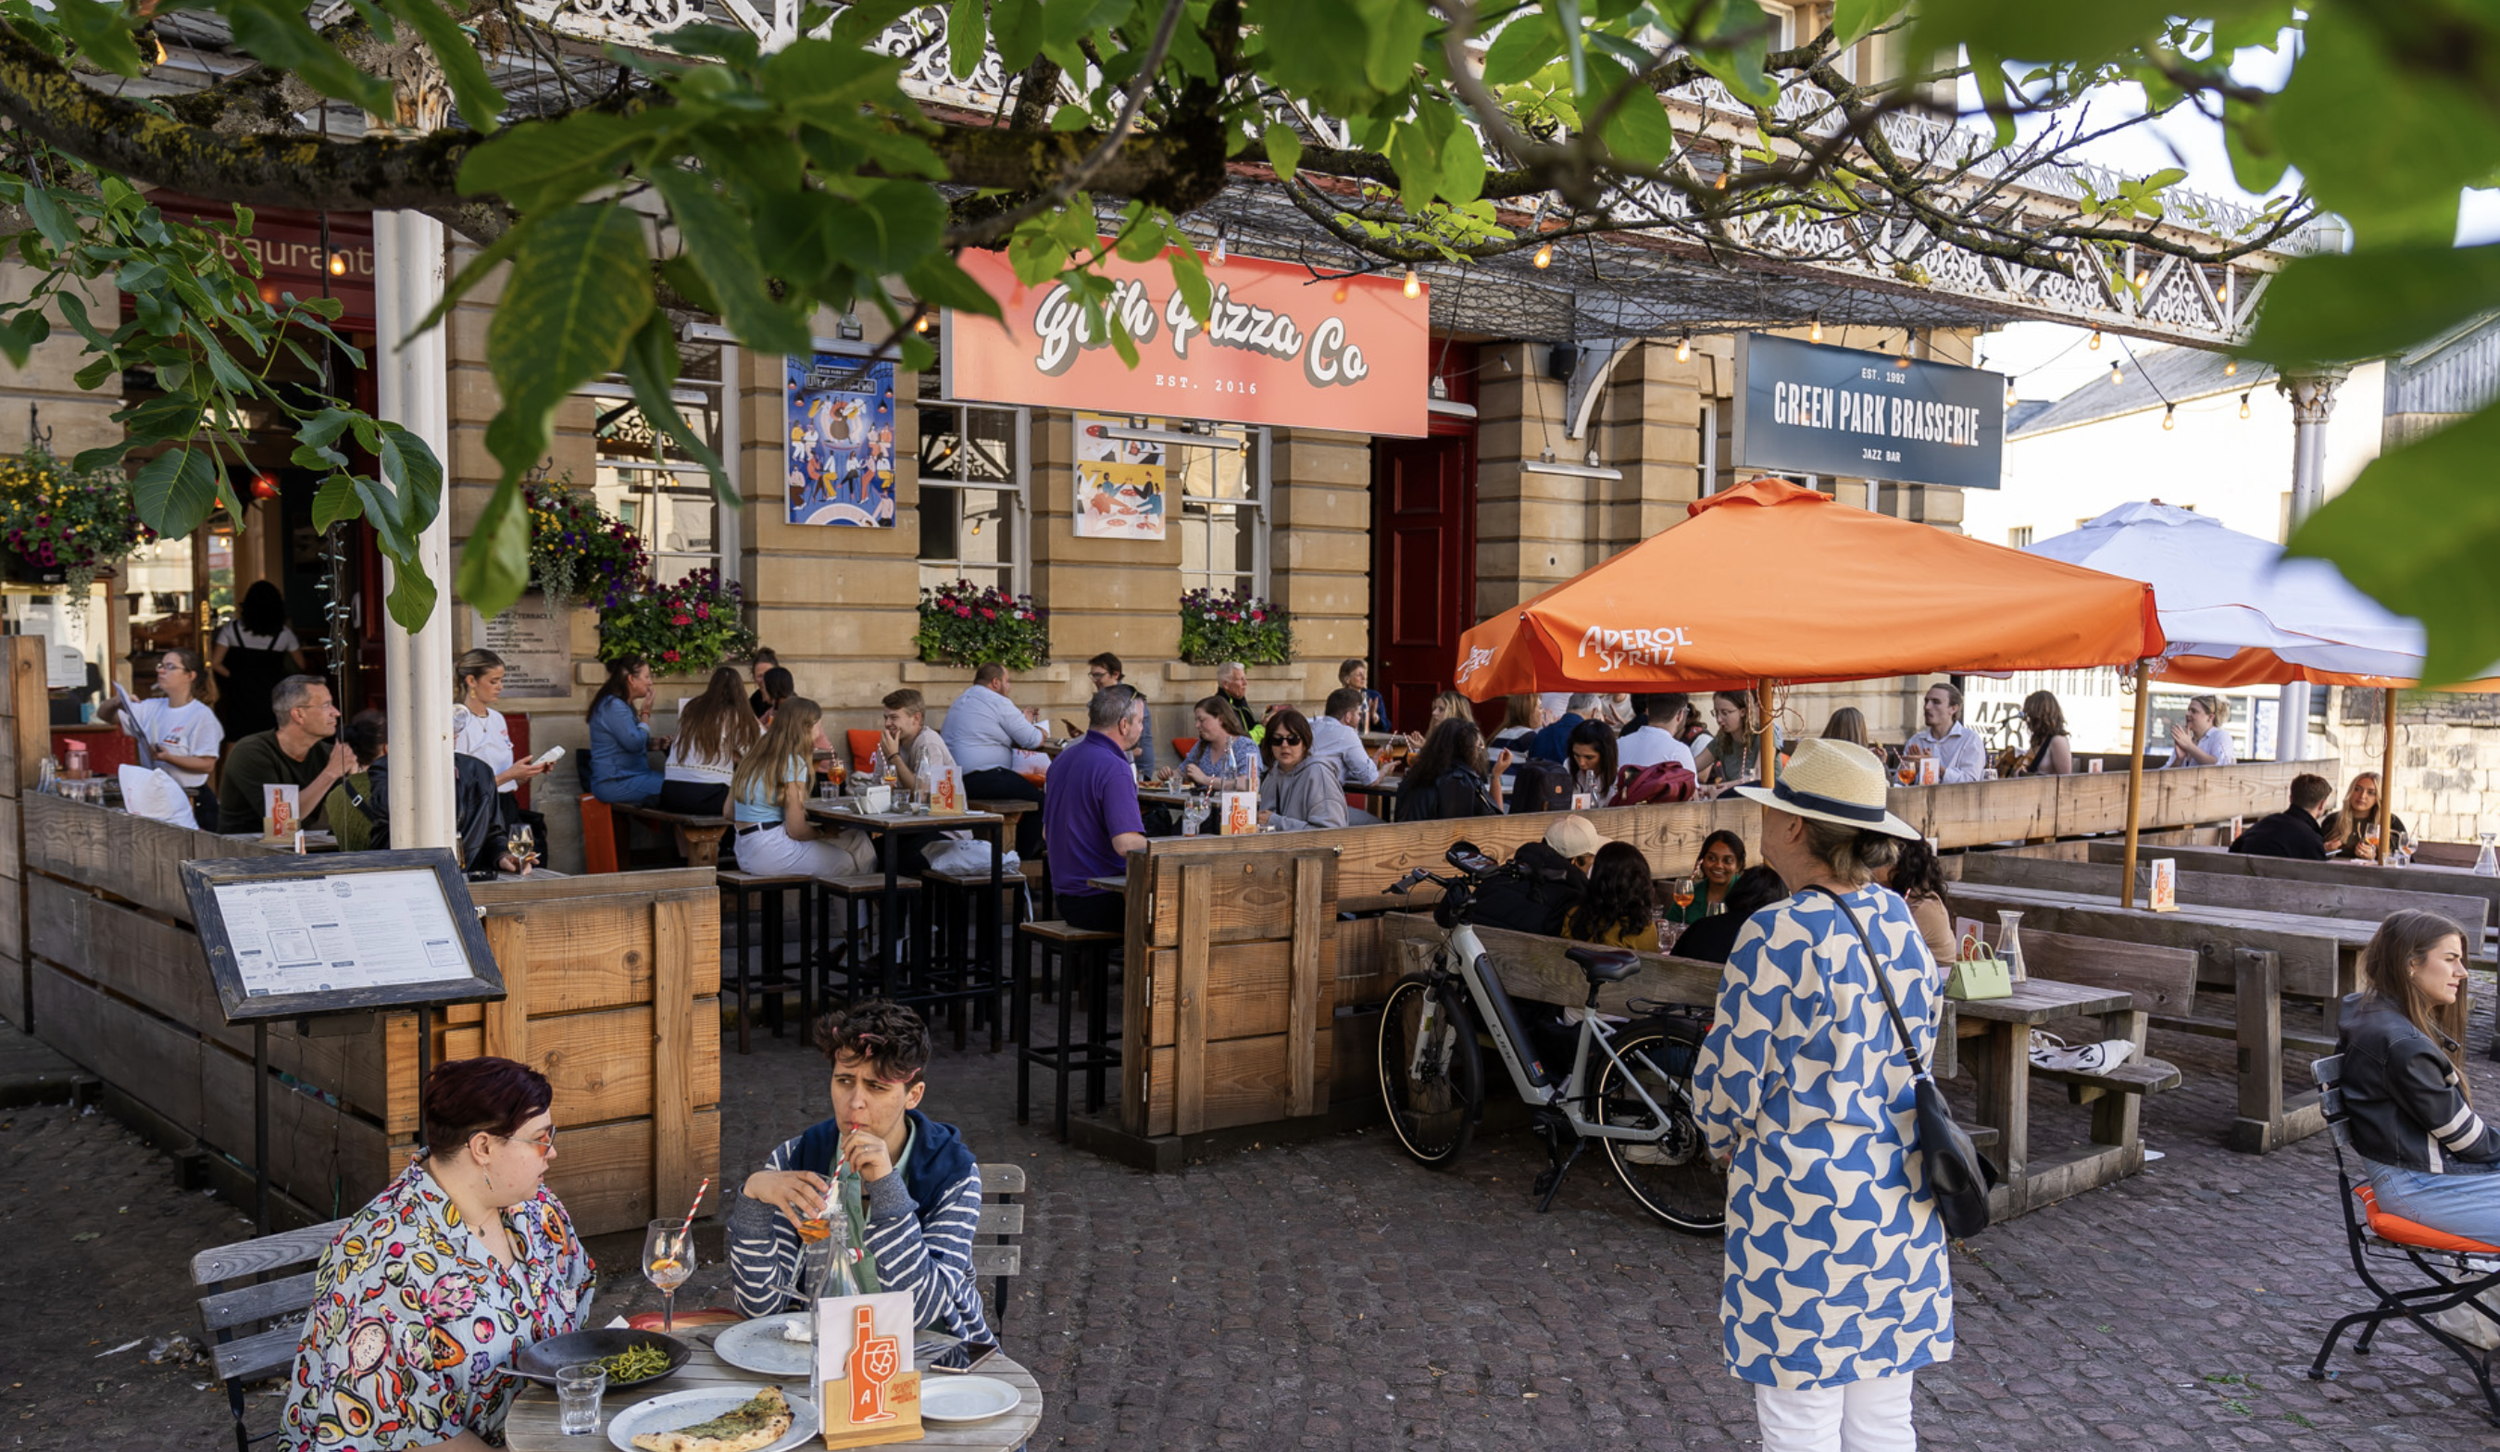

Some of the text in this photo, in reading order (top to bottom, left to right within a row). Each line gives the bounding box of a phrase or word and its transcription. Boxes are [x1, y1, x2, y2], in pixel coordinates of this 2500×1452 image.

[217, 233, 374, 276] taurant
[1308, 316, 1369, 384] Co
[1155, 374, 1257, 395] EST. 2016
[1861, 367, 1906, 384] EST. 1992
[1773, 381, 1980, 447] GREEN PARK BRASSERIE
[1862, 448, 1902, 463] JAZZ BAR
[1578, 625, 1693, 659] APEROL
[860, 1389, 871, 1405] A
